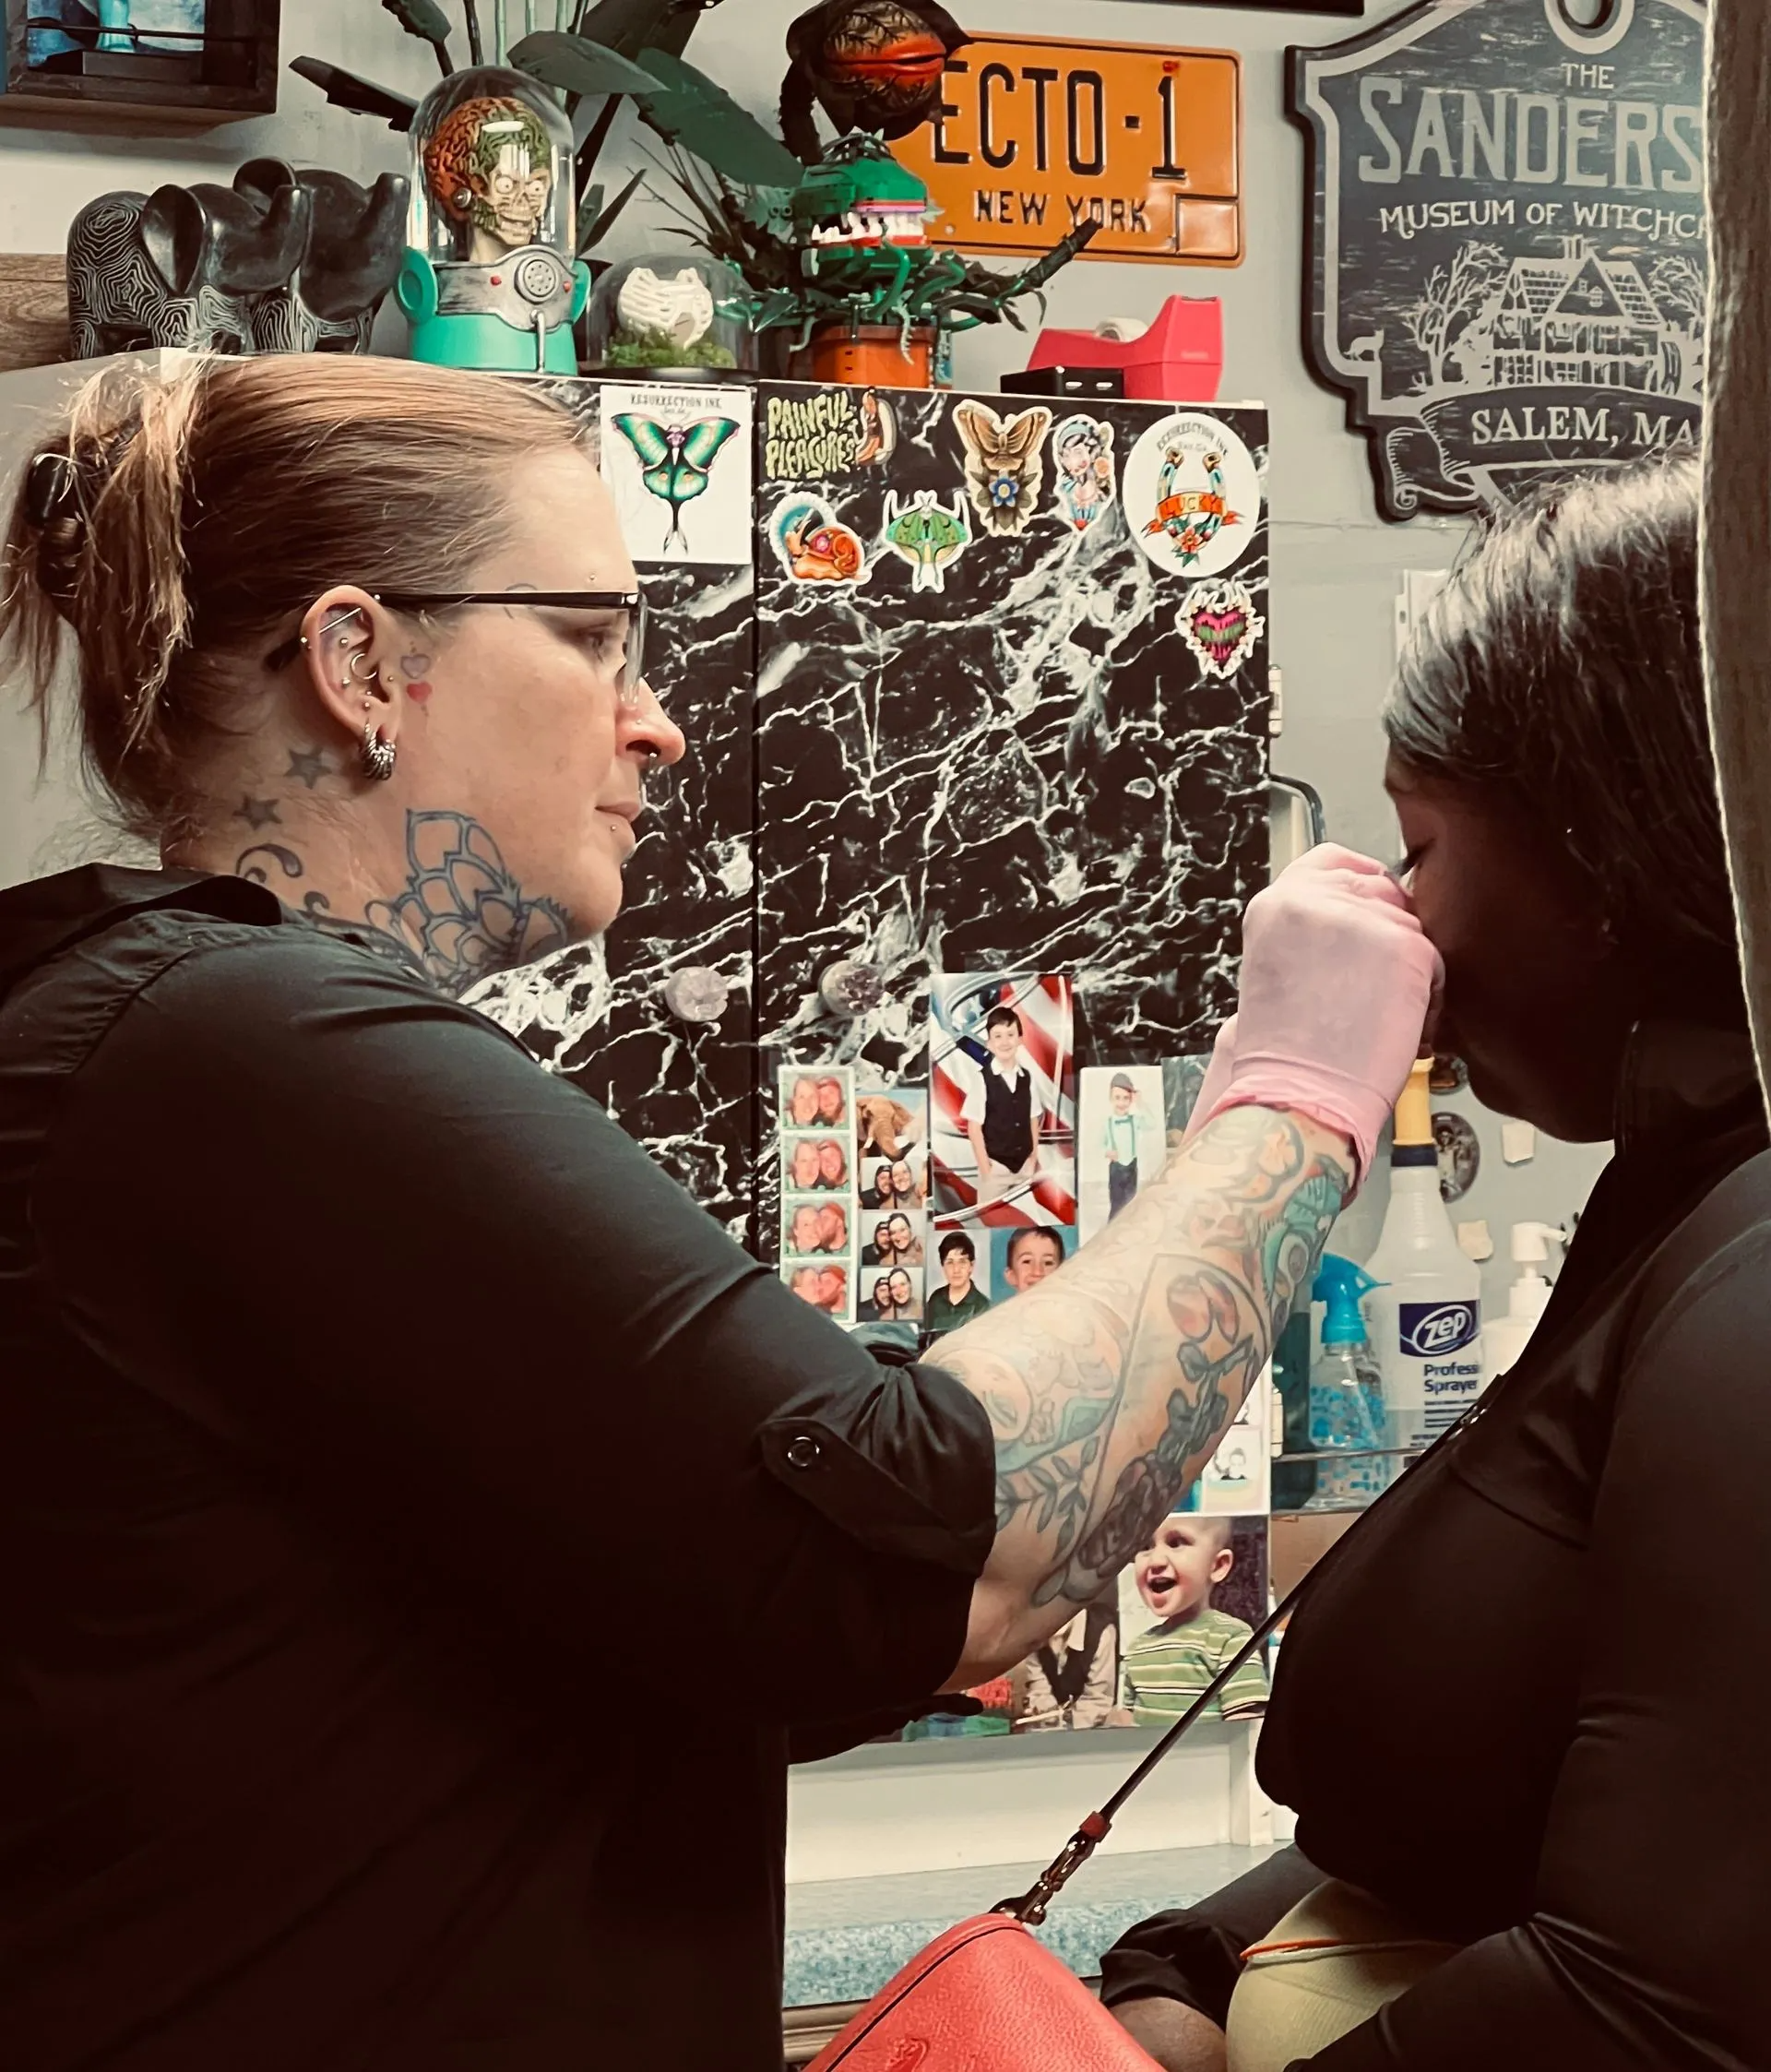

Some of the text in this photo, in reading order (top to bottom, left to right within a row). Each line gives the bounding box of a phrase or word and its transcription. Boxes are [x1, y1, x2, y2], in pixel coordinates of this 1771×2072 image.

[1562, 62, 1615, 90] THE
[933, 59, 1187, 180] ECTO-1
[1358, 77, 1703, 194] SANDERS
[975, 189, 1150, 233] NEW YORK
[1379, 198, 1515, 240] MUSEUM
[1526, 202, 1563, 226] OF
[767, 390, 853, 440] PAINFUL
[1470, 407, 1696, 448] SALEM, MA
[765, 431, 856, 480] PLEASURES
[1164, 494, 1219, 517] LUCKY
